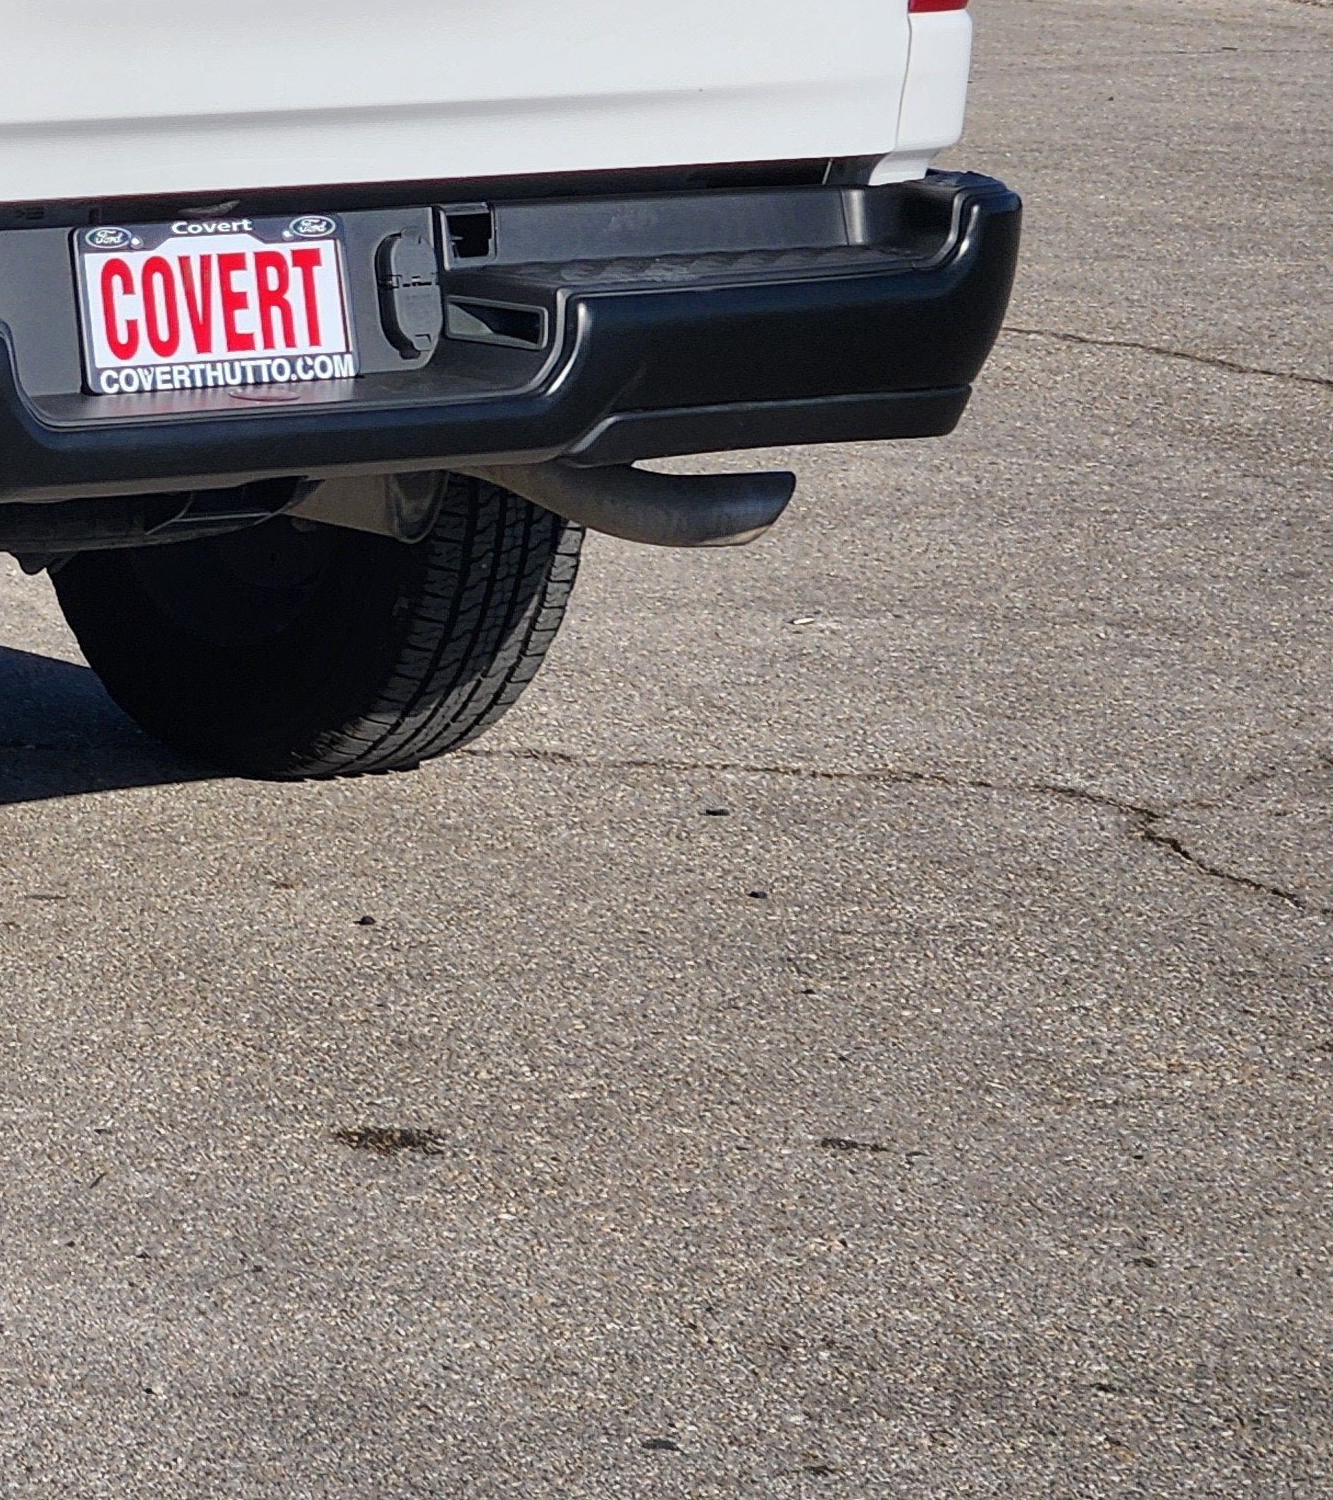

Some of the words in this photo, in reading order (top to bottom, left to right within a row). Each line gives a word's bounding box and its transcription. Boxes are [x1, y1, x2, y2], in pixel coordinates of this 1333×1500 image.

[171, 218, 253, 236] Covert
[100, 247, 323, 361] COVERT
[99, 353, 355, 394] COVERTHUTTO.COM
